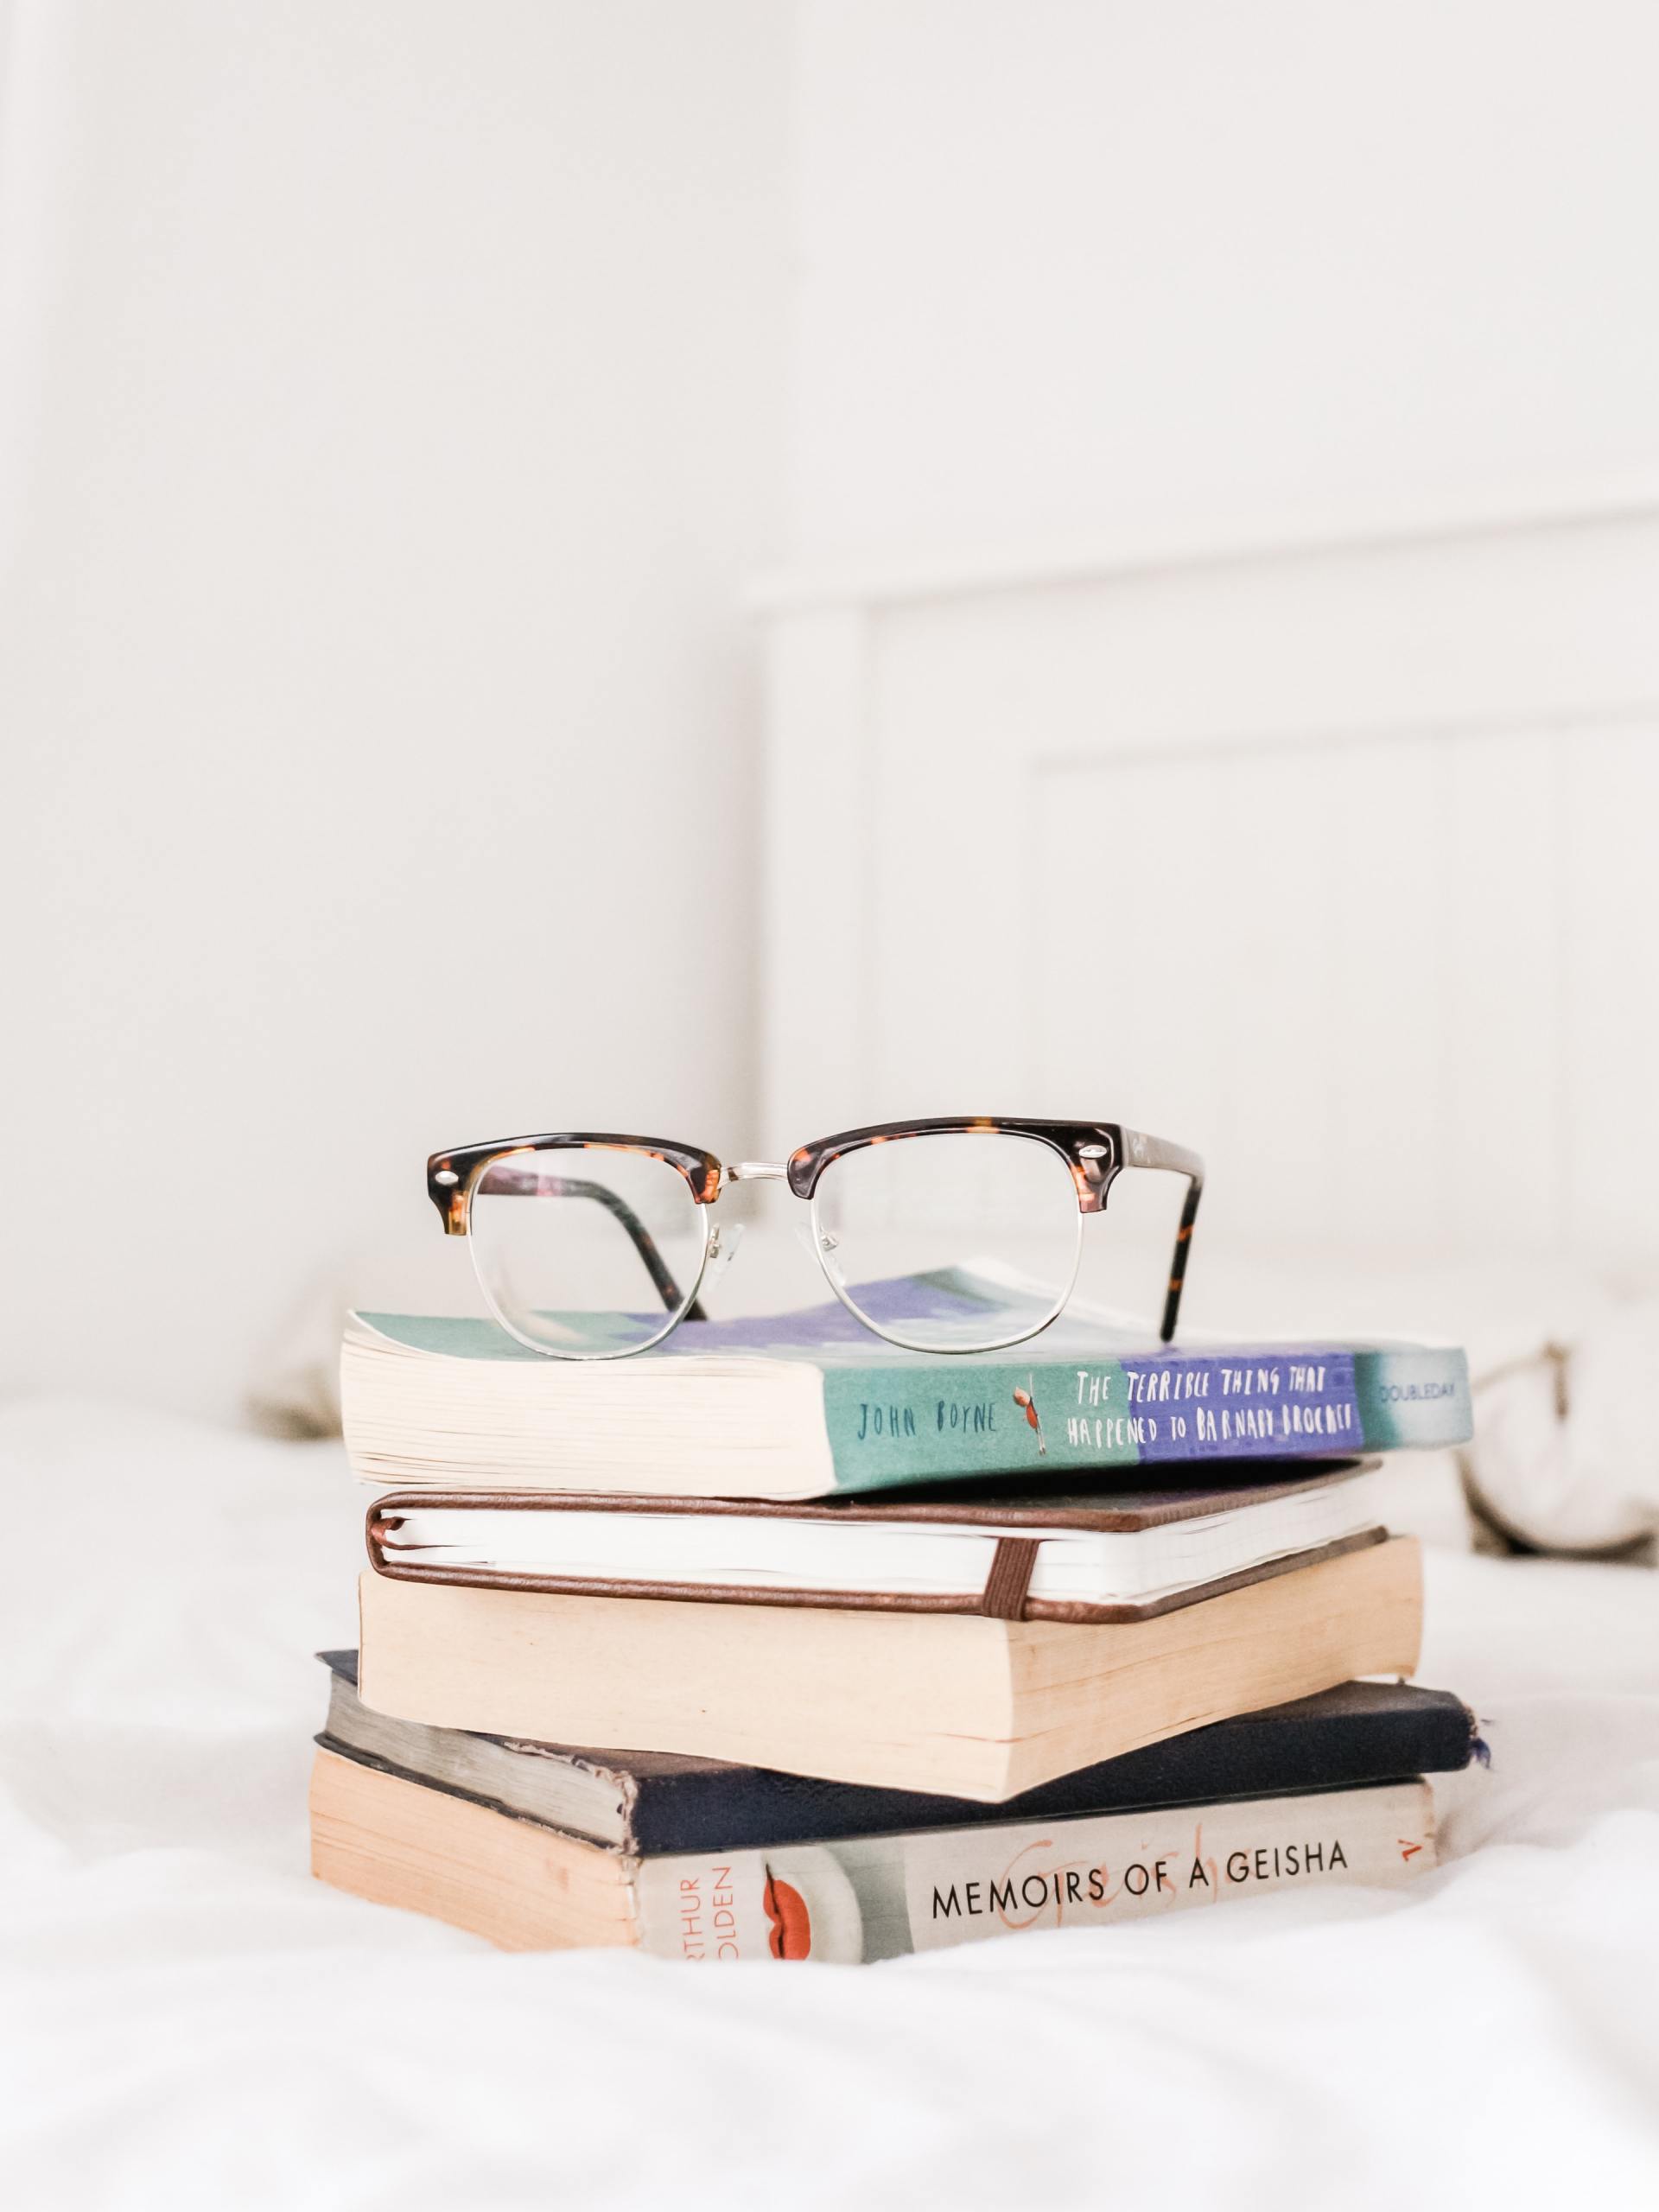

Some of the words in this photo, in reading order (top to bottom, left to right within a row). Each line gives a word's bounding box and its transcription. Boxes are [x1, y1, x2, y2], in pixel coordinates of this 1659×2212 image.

[1077, 1370, 1111, 1407] THE
[1127, 1370, 1210, 1403] TERRIBLE
[1221, 1367, 1280, 1395] THING
[1289, 1365, 1326, 1392] THAT
[1380, 1382, 1455, 1402] DOUBLEDAY
[857, 1402, 917, 1441] JOHN
[936, 1400, 996, 1433] BOYNE
[1067, 1416, 1157, 1449] HAPPENED
[1170, 1415, 1186, 1440] TO
[1196, 1406, 1274, 1442] BARNABY
[1281, 1403, 1352, 1435] BROCKET
[932, 1867, 1104, 1919] MEMOIRS
[1123, 1859, 1167, 1896] OF
[1188, 1856, 1210, 1889] A
[1225, 1840, 1349, 1883] GEISHA
